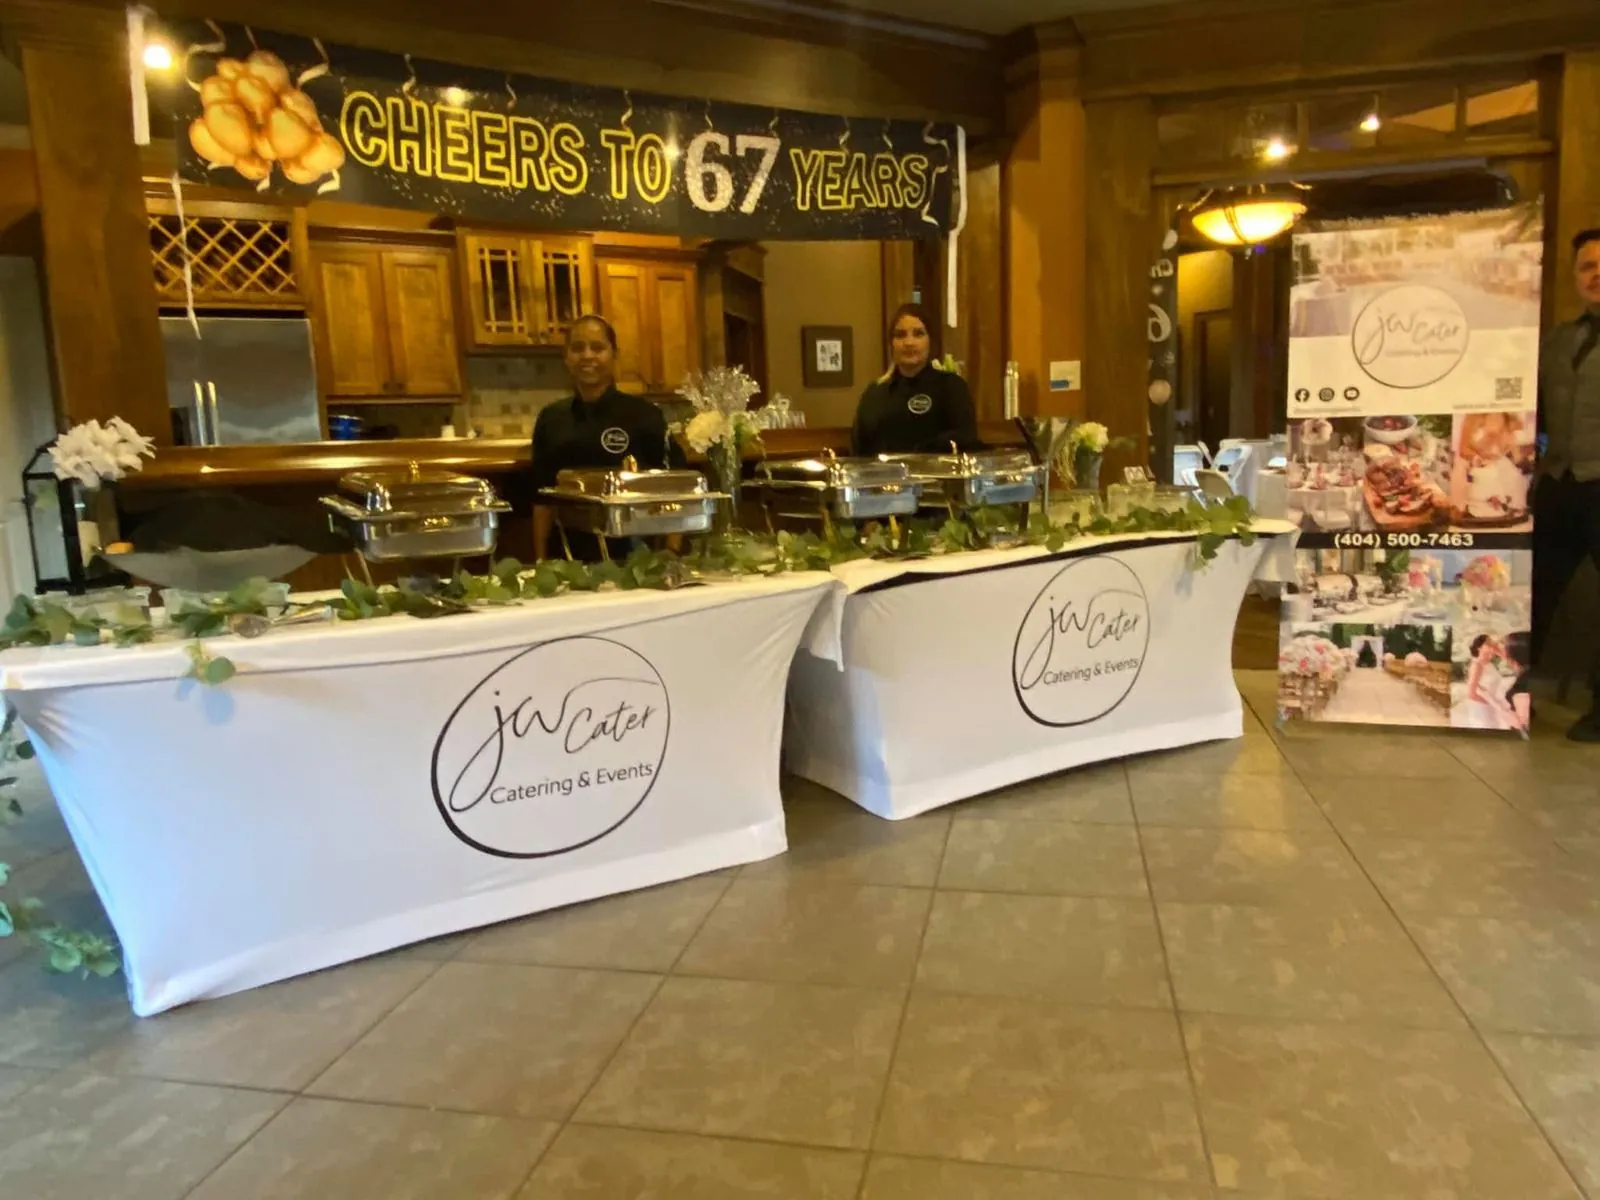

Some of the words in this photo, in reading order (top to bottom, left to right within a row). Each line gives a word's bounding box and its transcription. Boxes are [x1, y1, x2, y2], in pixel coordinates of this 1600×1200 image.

[340, 91, 588, 195] CHEERS
[600, 129, 672, 203] TO
[685, 132, 781, 214] 67
[790, 149, 928, 210] YEARS
[1334, 532, 1381, 548] (404)
[1387, 532, 1474, 547] 500-7463
[1087, 608, 1141, 649] Cater
[1043, 667, 1091, 686] Catering
[1093, 662, 1102, 676] &
[1105, 657, 1140, 675] Events
[564, 701, 657, 754] Cater
[489, 777, 573, 804] Catering
[577, 771, 592, 788] &
[596, 761, 654, 785] Events
